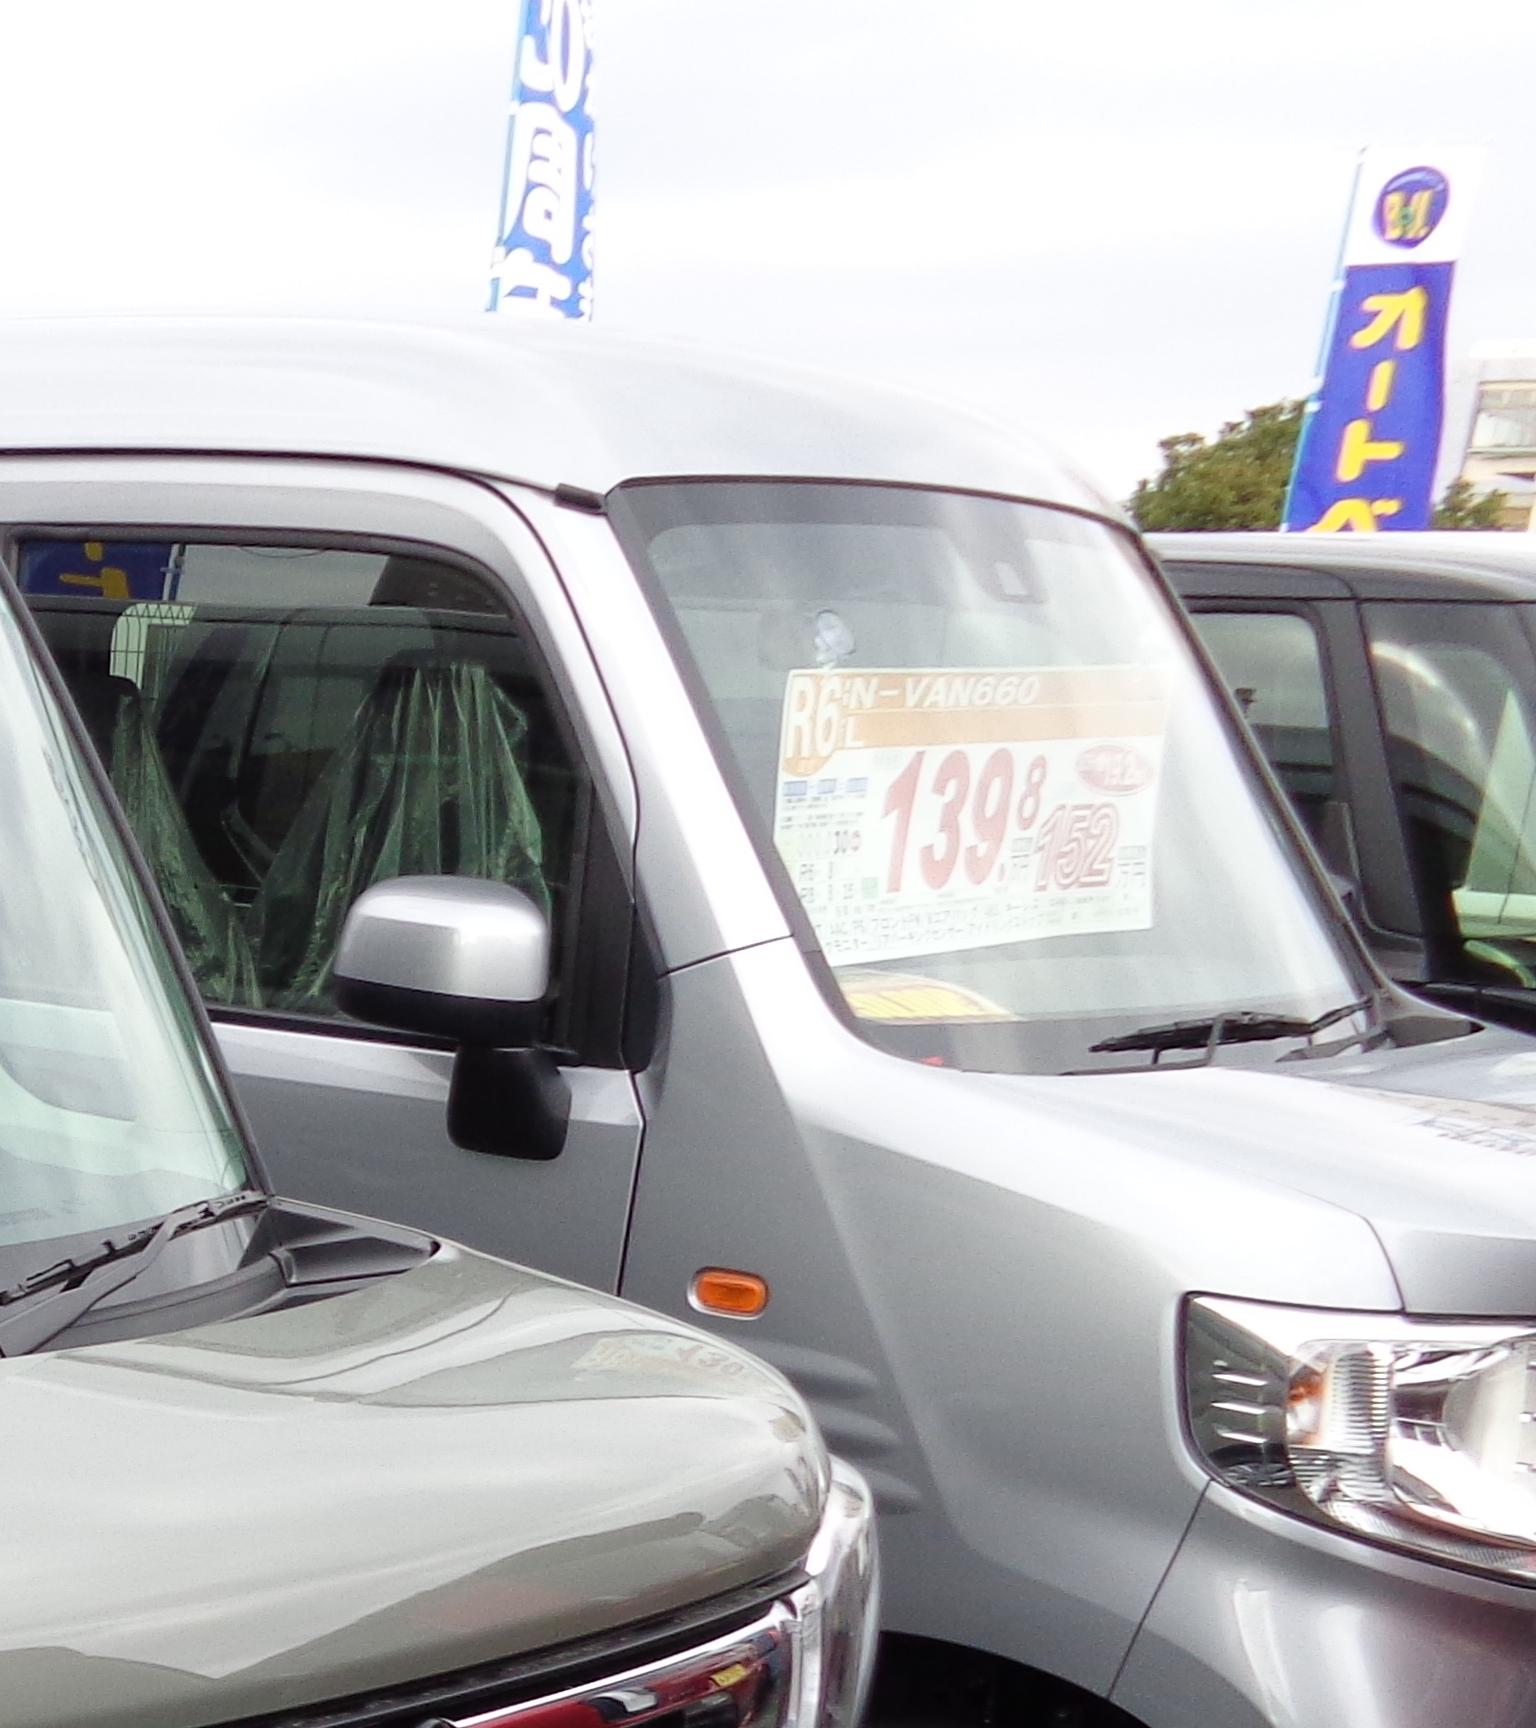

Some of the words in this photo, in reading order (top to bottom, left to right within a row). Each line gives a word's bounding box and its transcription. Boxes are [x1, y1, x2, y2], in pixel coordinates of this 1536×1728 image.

[784, 675, 843, 758] R6
[845, 675, 1040, 708] N-VAN660
[1034, 803, 1119, 893] 152
